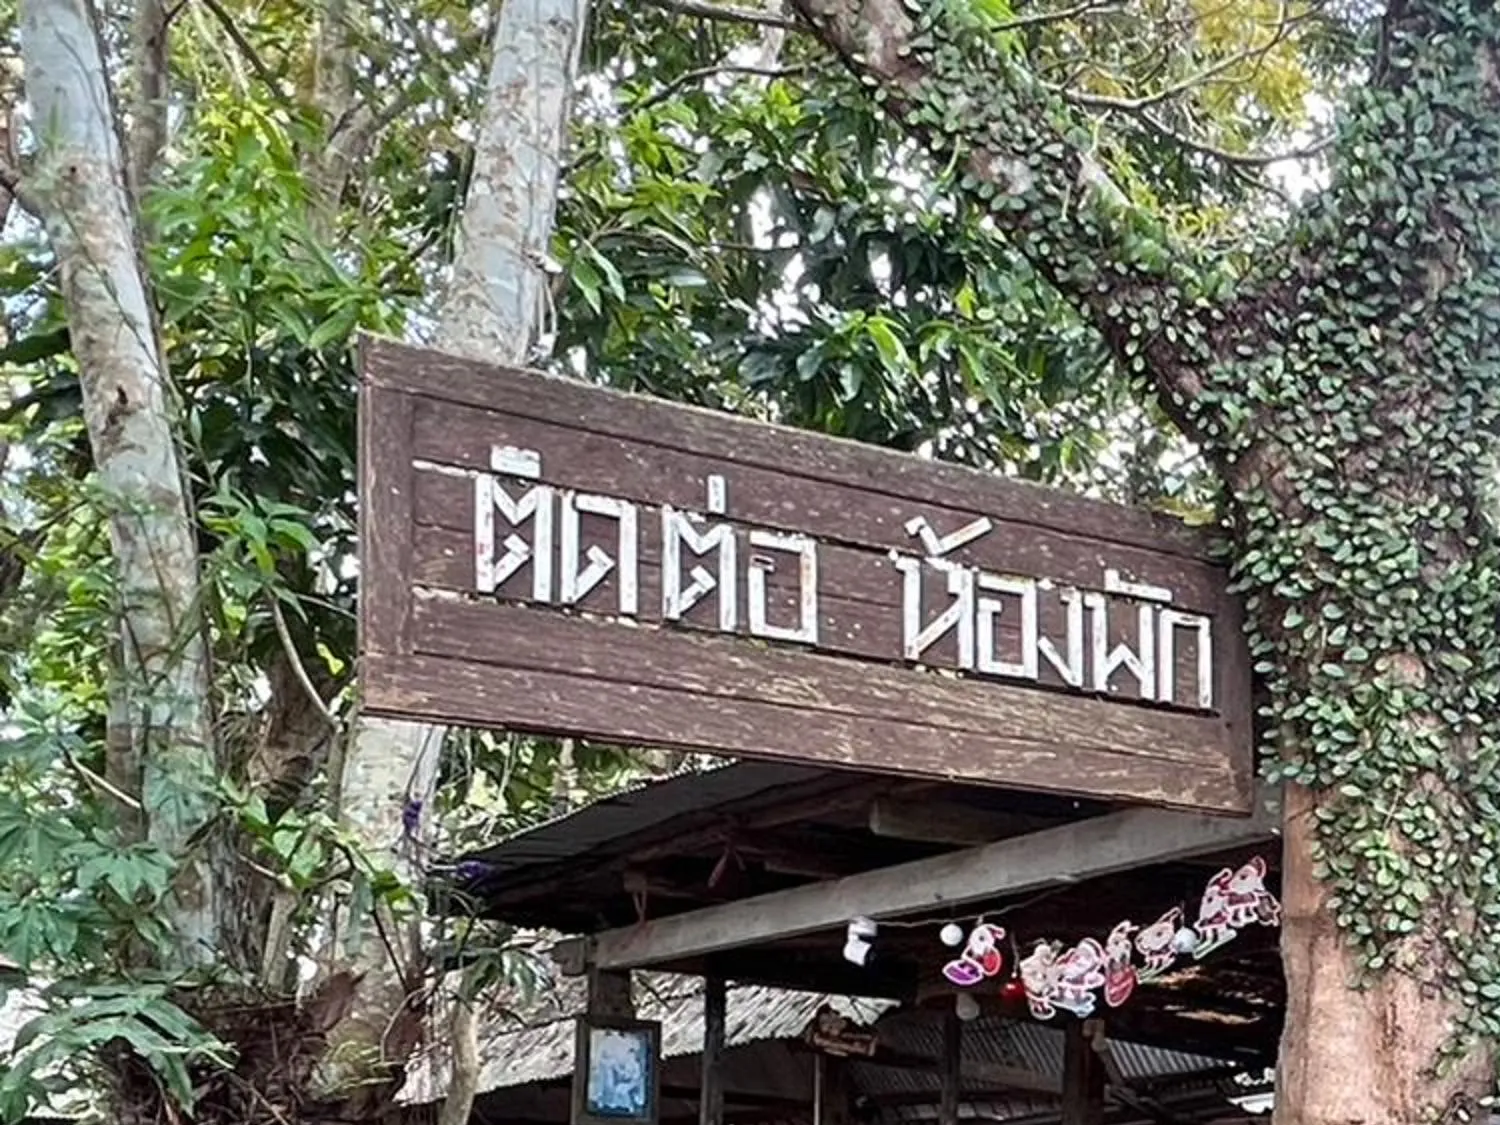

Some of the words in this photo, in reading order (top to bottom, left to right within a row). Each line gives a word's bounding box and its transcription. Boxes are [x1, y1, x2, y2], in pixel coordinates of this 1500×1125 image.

[474, 444, 818, 643] ติดต่อ
[895, 516, 1213, 709] ห้องพัก
